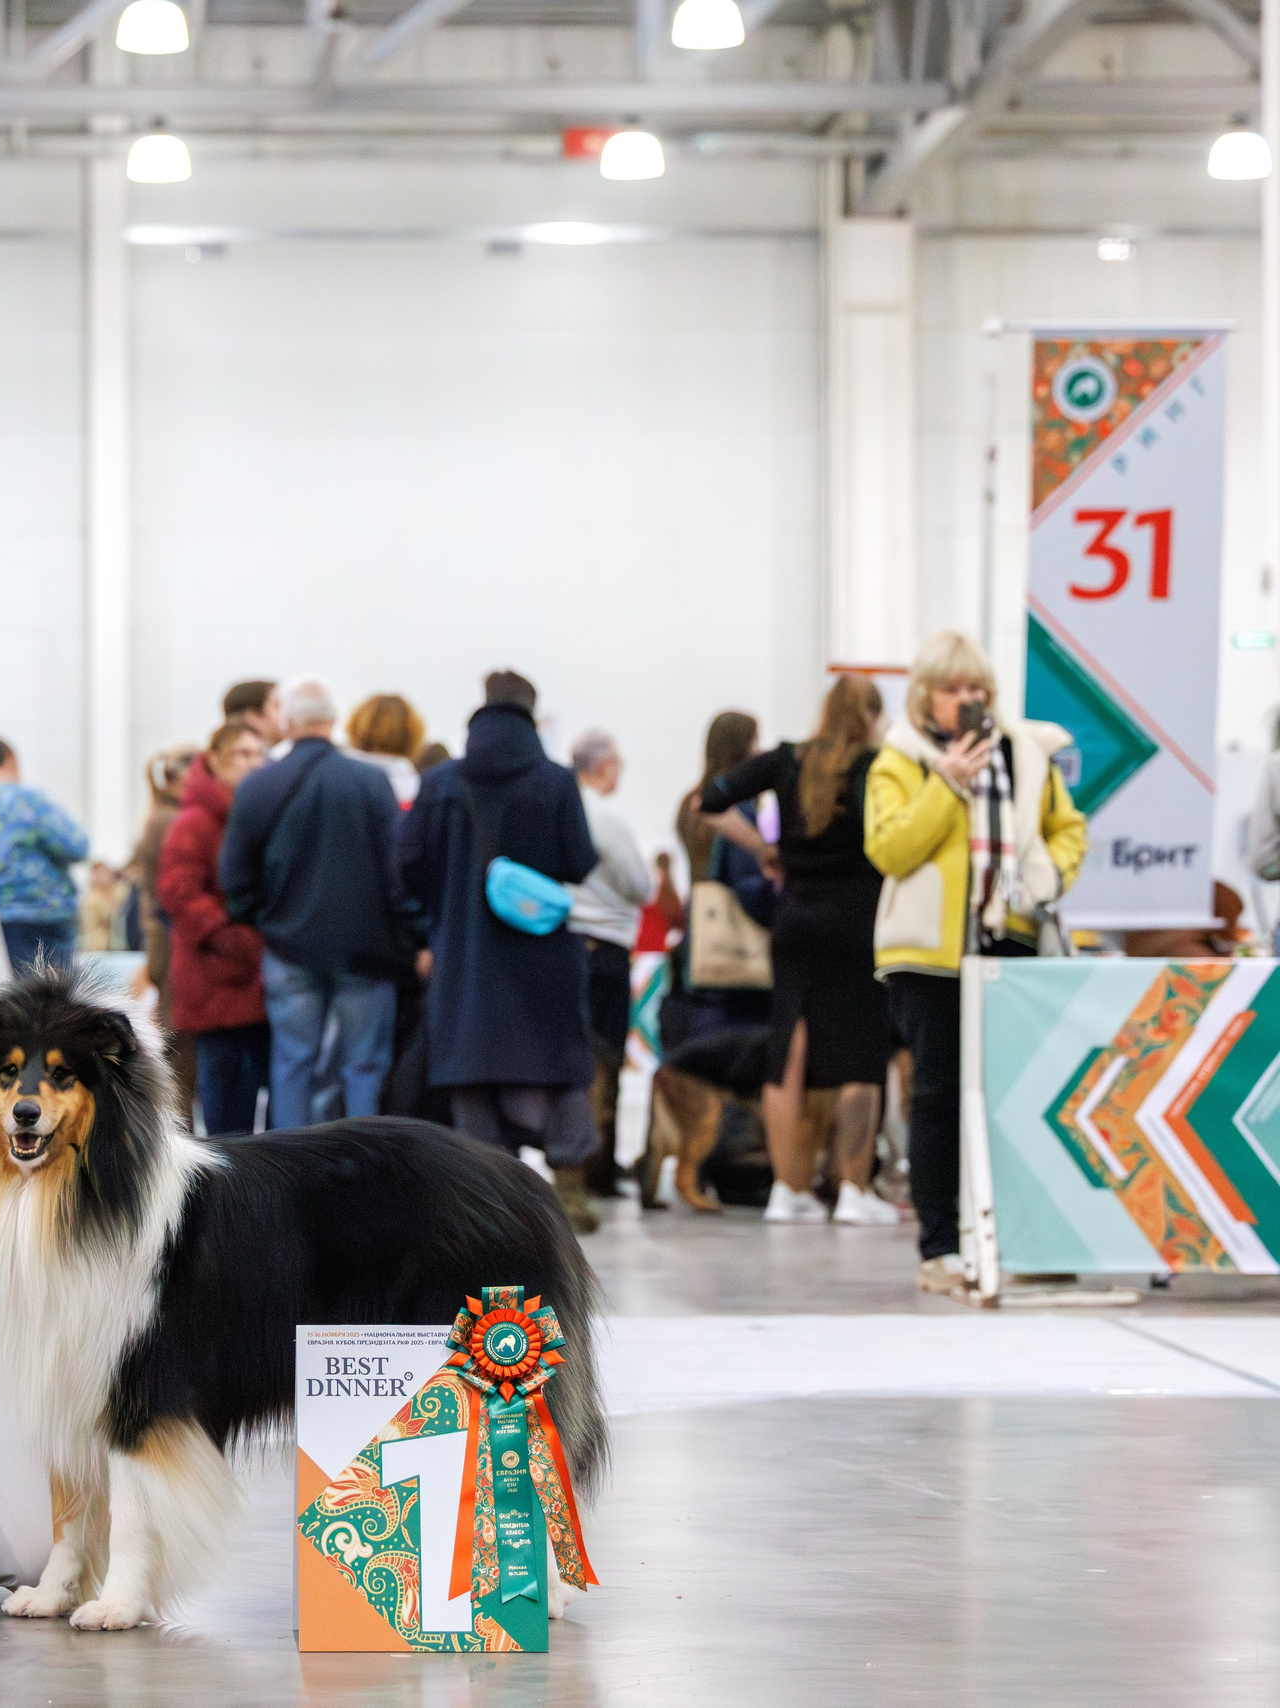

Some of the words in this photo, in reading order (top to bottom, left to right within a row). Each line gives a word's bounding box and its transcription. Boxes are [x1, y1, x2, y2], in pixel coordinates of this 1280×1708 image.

[1068, 507, 1173, 600] 31
[306, 1378, 408, 1397] DINNER
[324, 1357, 389, 1376] BEST
[381, 1430, 473, 1632] 1
